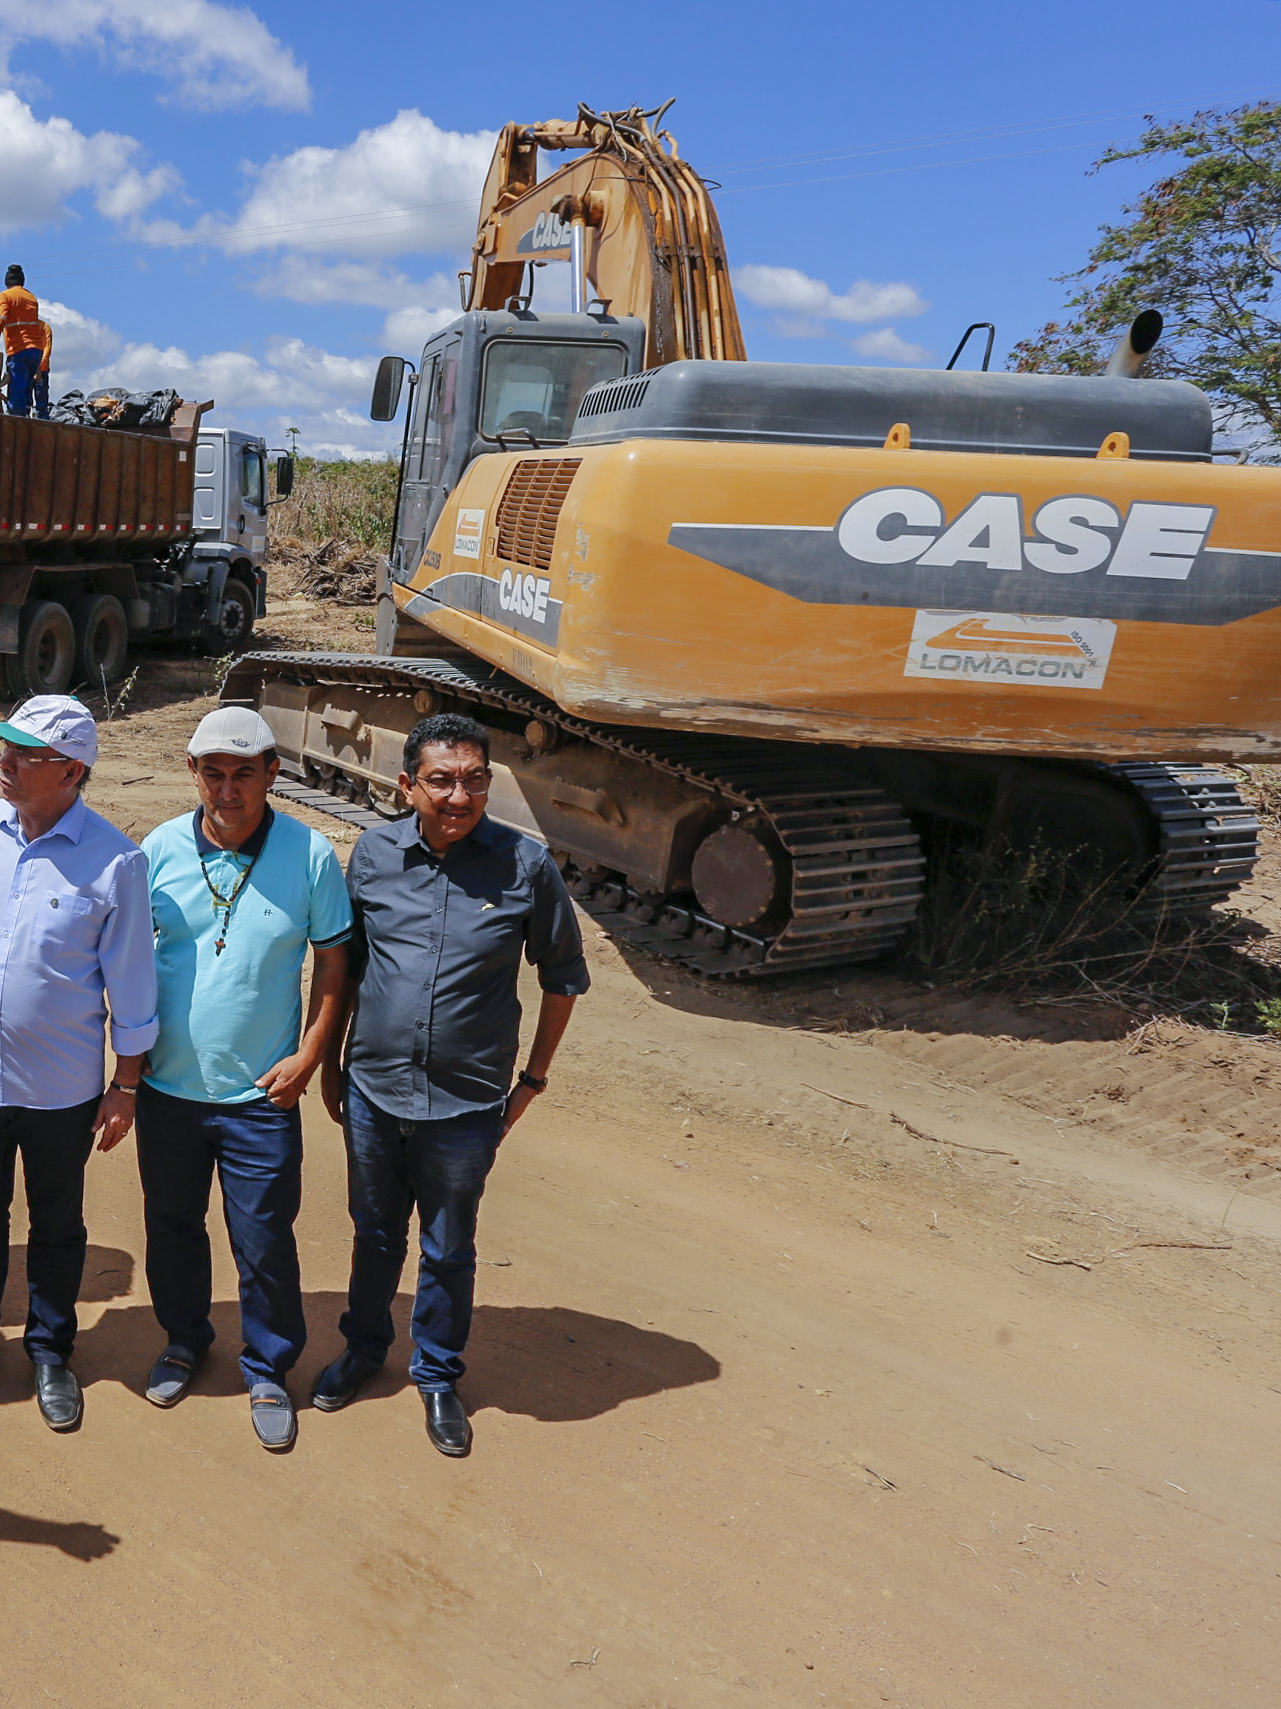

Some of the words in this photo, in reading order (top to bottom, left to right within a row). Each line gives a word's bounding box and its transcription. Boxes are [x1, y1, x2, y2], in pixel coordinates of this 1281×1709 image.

[532, 211, 571, 249] CASE
[838, 488, 1215, 580] CASE
[499, 568, 551, 624] CASE
[1070, 630, 1083, 643] ISO
[1079, 641, 1095, 657] 9001
[919, 653, 1086, 679] LOMACON
